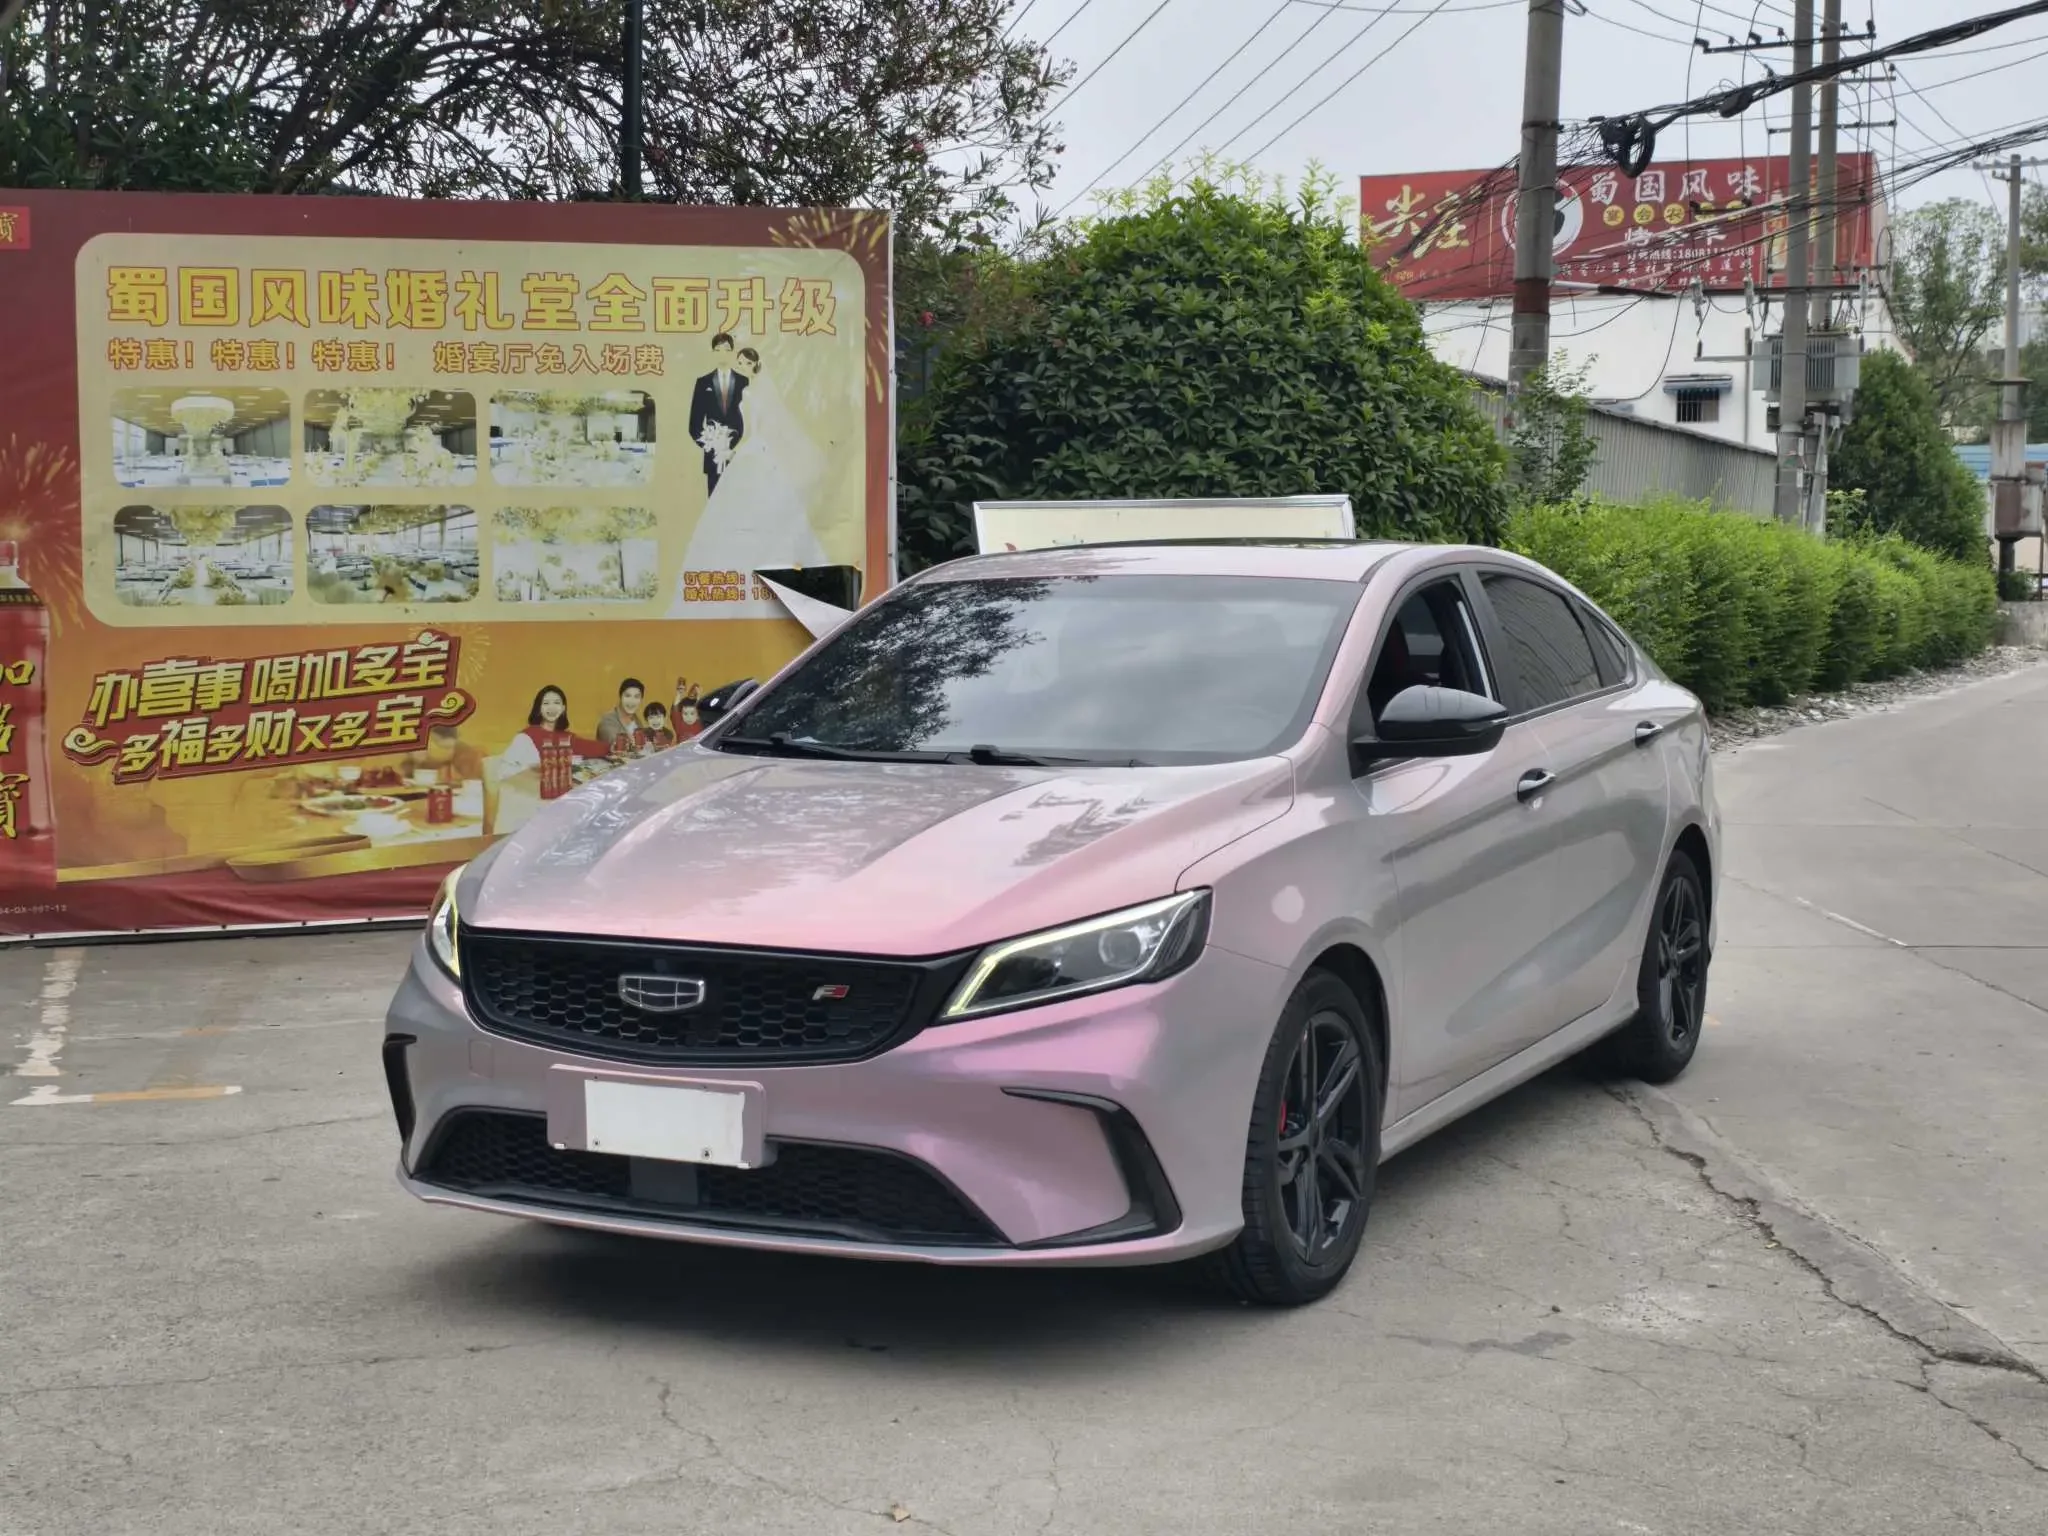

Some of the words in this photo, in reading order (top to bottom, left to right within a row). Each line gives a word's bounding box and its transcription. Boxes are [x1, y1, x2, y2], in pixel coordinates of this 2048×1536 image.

[1589, 165, 1762, 205] 蜀国风味
[107, 266, 837, 336] 蜀国风味婚礼堂全面升级
[433, 341, 665, 376] 婚宴厅免入场费
[116, 694, 424, 775] 多福多财又多宝
